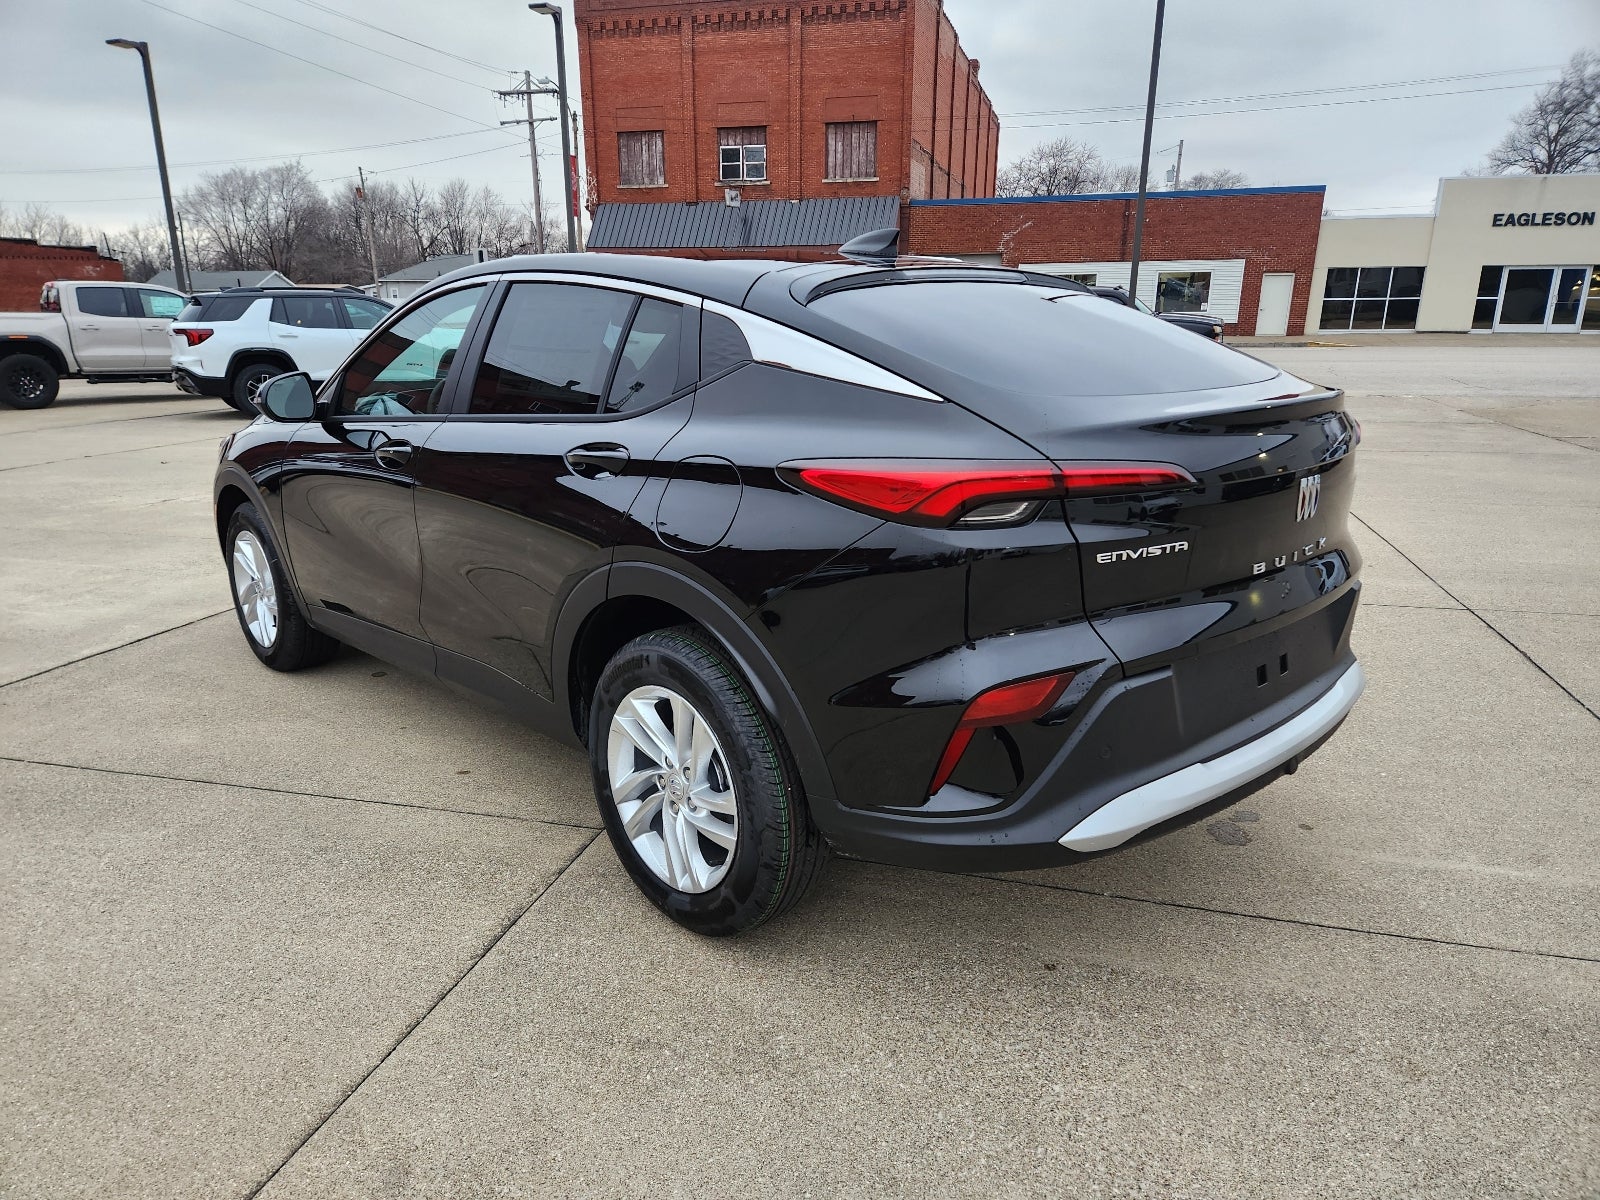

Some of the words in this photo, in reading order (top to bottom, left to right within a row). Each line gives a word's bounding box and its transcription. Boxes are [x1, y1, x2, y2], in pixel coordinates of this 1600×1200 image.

[1492, 211, 1596, 227] EAGLESON
[1096, 541, 1189, 564] ENVISTA
[1252, 537, 1327, 575] BUICK
